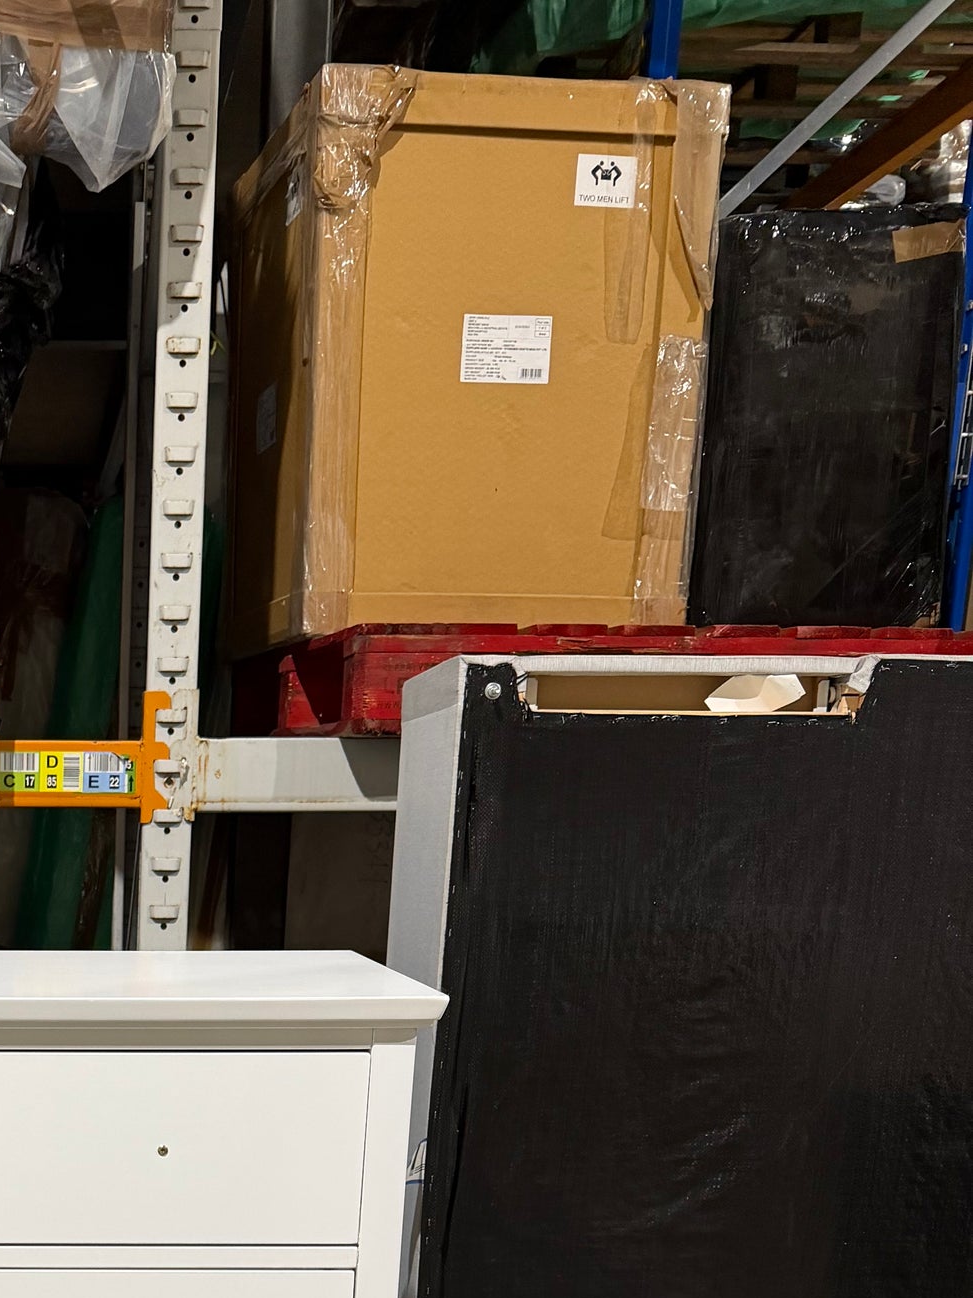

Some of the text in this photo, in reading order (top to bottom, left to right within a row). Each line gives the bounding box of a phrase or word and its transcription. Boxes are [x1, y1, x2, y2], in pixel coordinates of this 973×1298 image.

[578, 194, 629, 204] TWO MEN LIFT
[46, 755, 59, 768] D
[3, 774, 35, 788] C 17
[46, 774, 57, 788] 85
[88, 775, 120, 789] E 22
